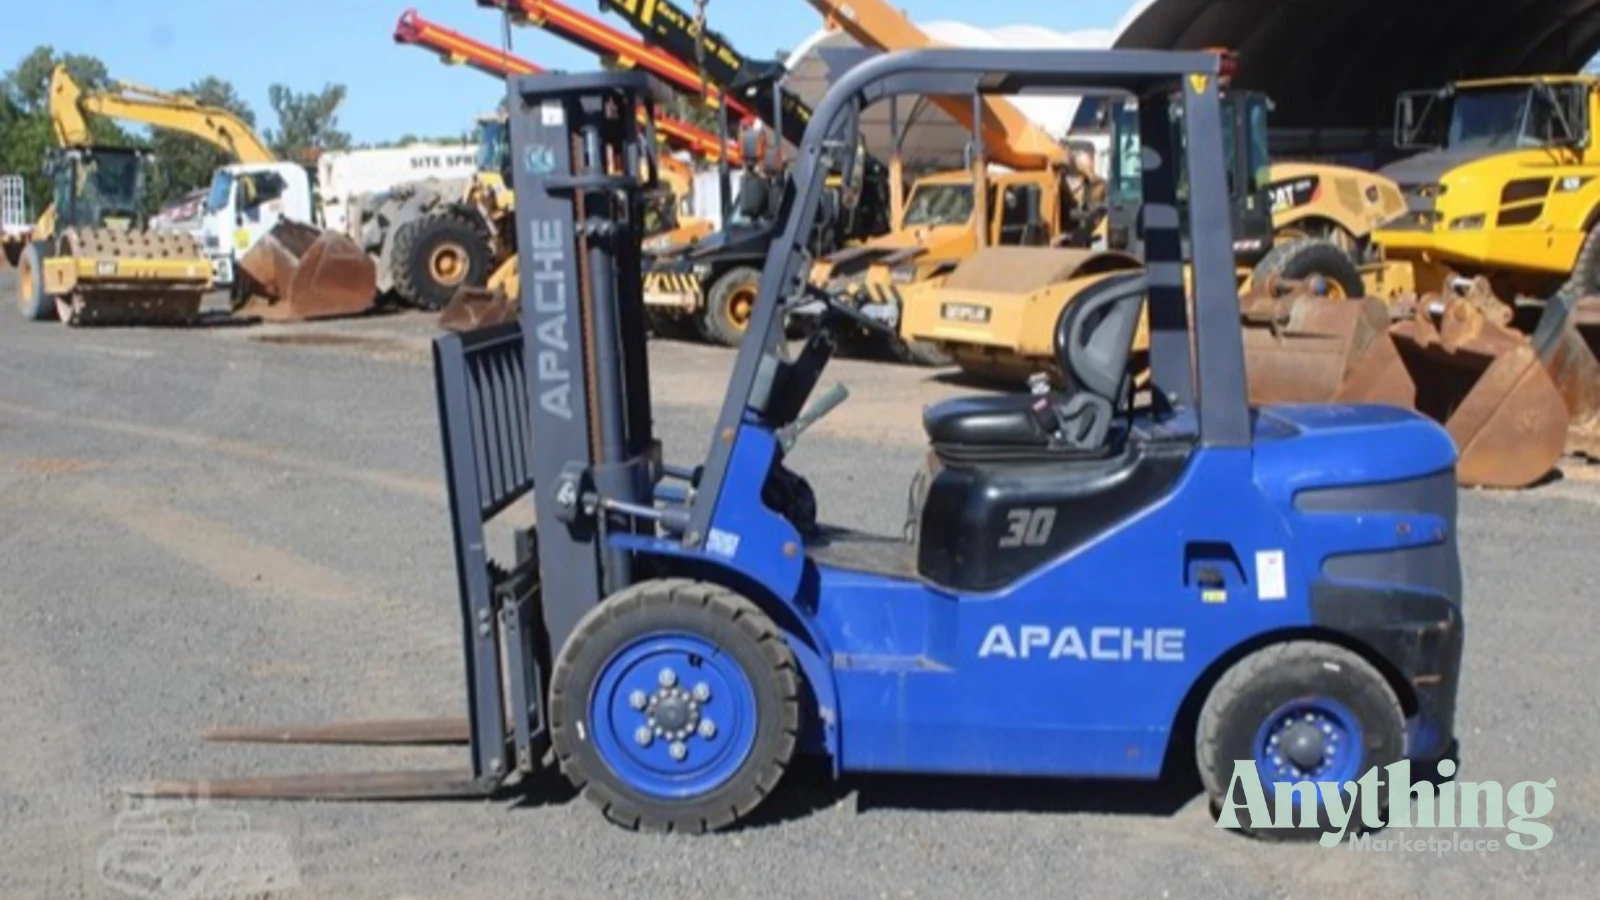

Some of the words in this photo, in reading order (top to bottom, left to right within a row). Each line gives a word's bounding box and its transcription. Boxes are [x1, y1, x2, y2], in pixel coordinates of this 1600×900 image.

[410, 155, 441, 170] SITE
[530, 218, 573, 421] APACHE
[998, 507, 1057, 548] 30
[977, 623, 1186, 661] APACHE
